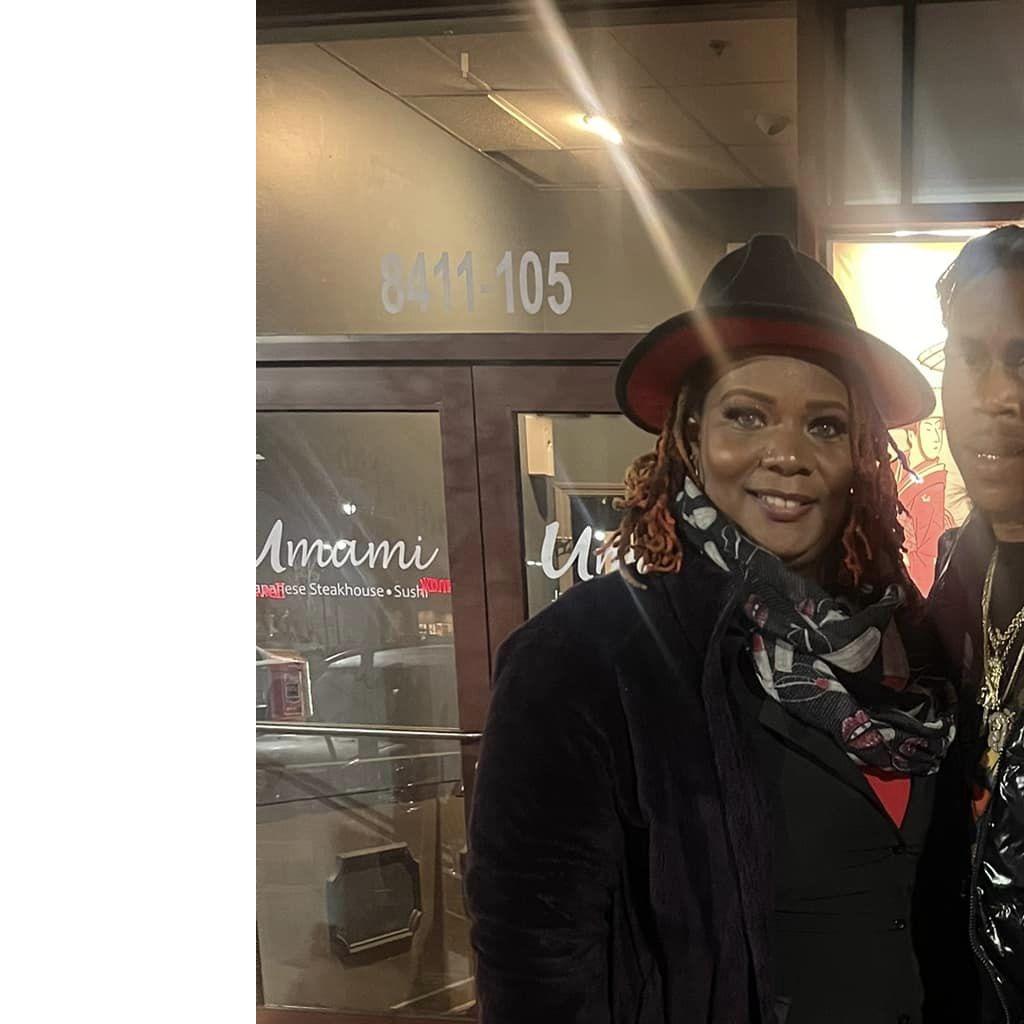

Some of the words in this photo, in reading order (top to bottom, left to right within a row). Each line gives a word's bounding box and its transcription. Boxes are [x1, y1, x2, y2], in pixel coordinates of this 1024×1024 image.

[380, 250, 572, 315] 8411-105
[309, 583, 384, 597] Steakhouse
[394, 585, 428, 598] Sushi
